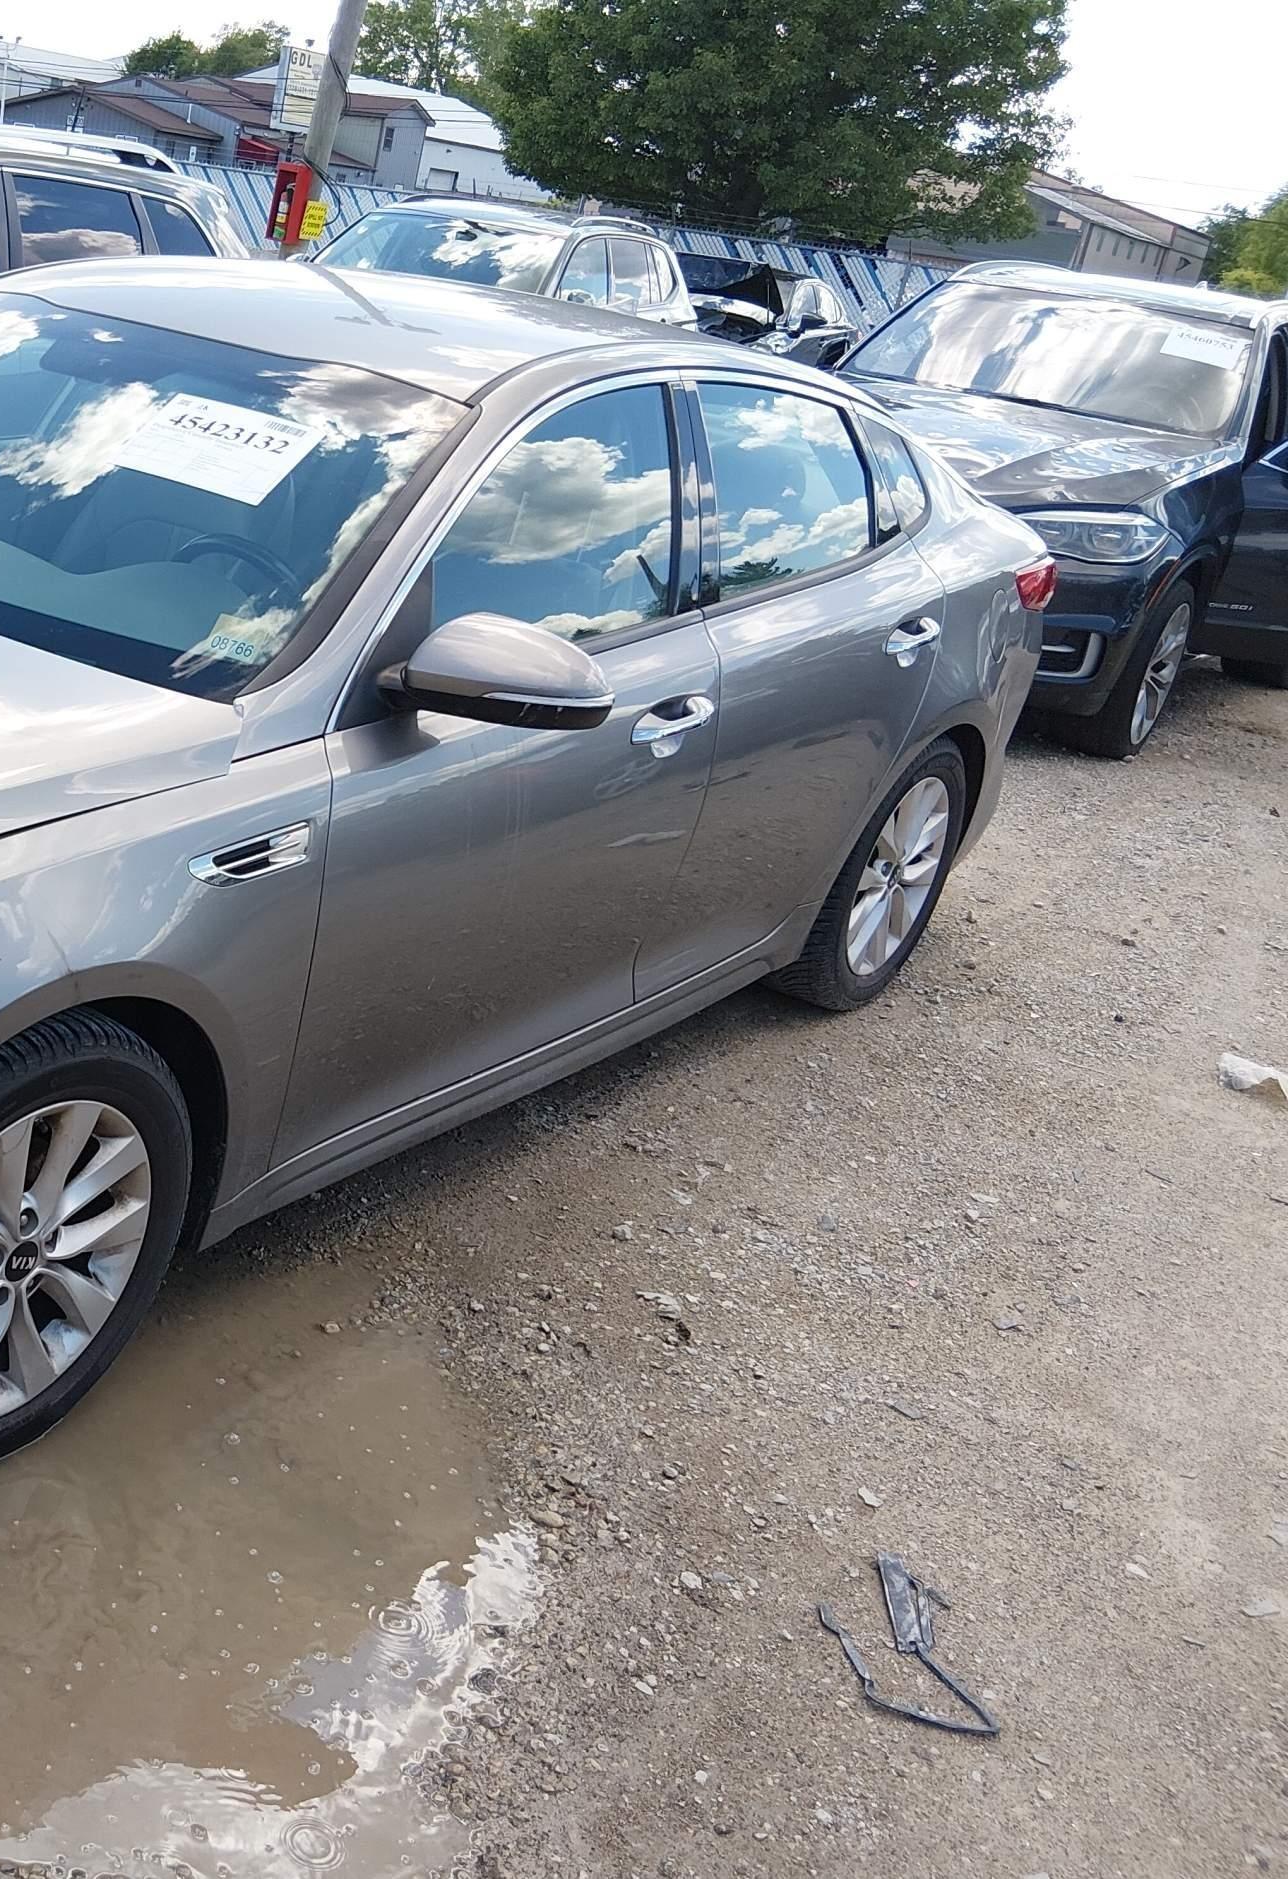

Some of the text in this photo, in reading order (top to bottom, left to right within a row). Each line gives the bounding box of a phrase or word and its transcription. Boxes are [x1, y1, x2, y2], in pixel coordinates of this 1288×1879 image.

[292, 51, 312, 69] GDL
[169, 414, 290, 454] 45423132
[211, 635, 254, 657] 08766
[11, 1256, 35, 1270] KIA
